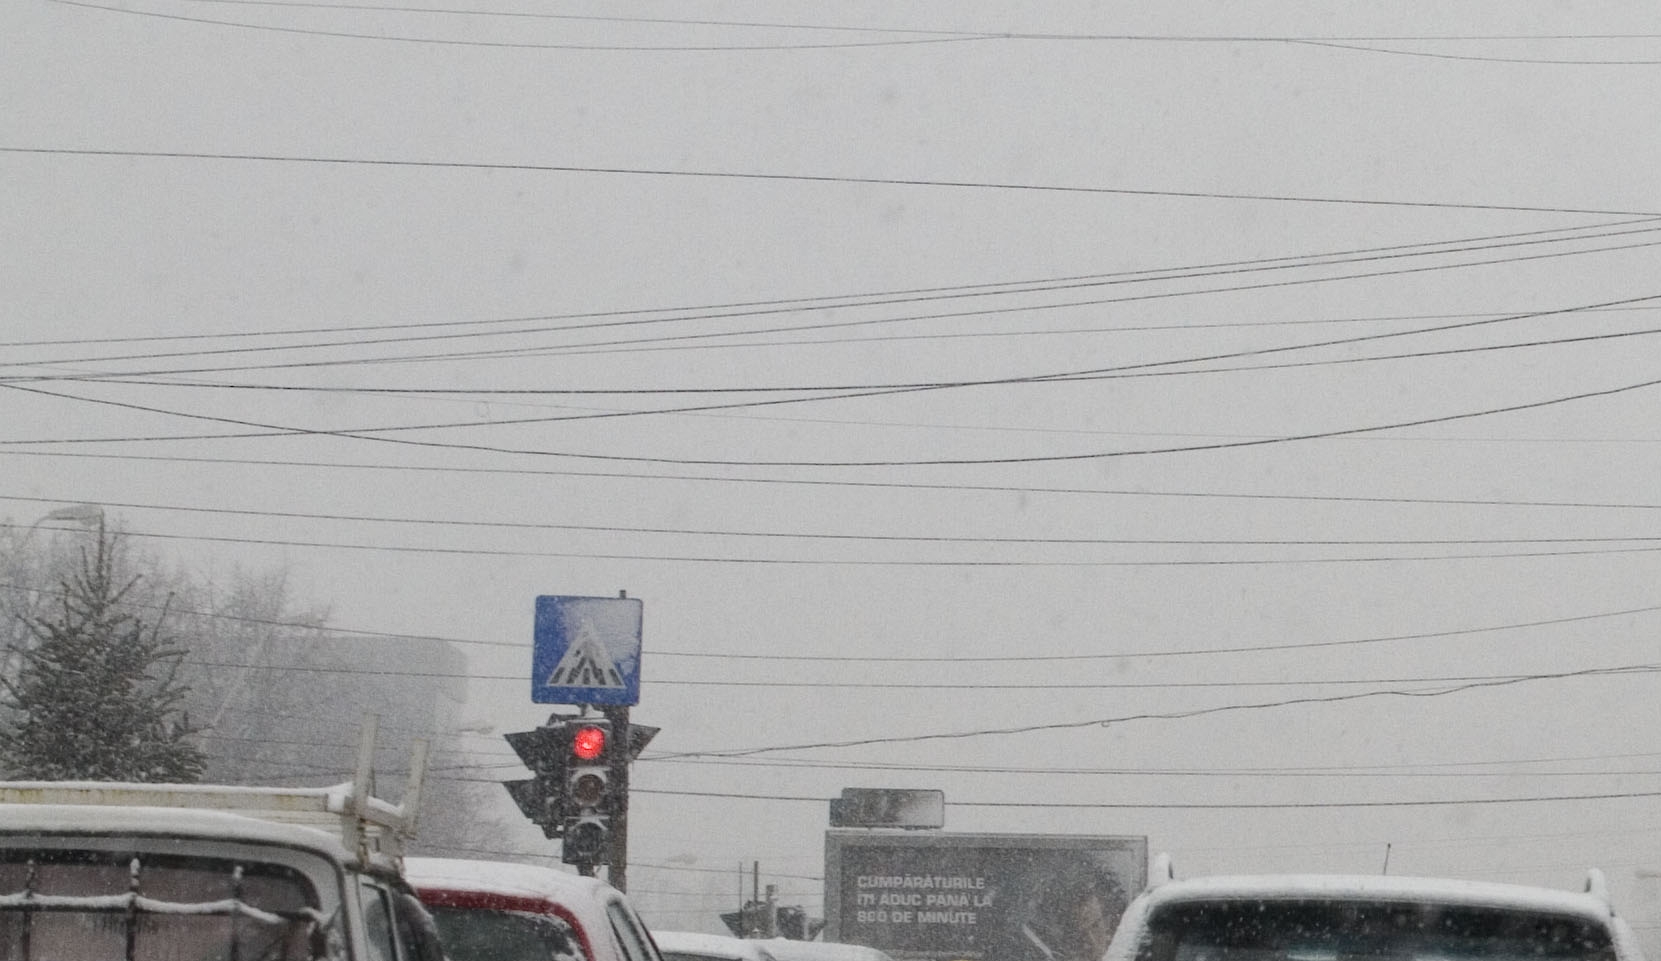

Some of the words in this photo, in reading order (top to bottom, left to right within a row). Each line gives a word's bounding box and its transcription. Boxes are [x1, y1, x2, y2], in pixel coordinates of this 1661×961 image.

[879, 893, 922, 906] ADUC
[973, 895, 993, 907] LA
[891, 911, 913, 923] DE
[917, 911, 977, 924] MINUTE
